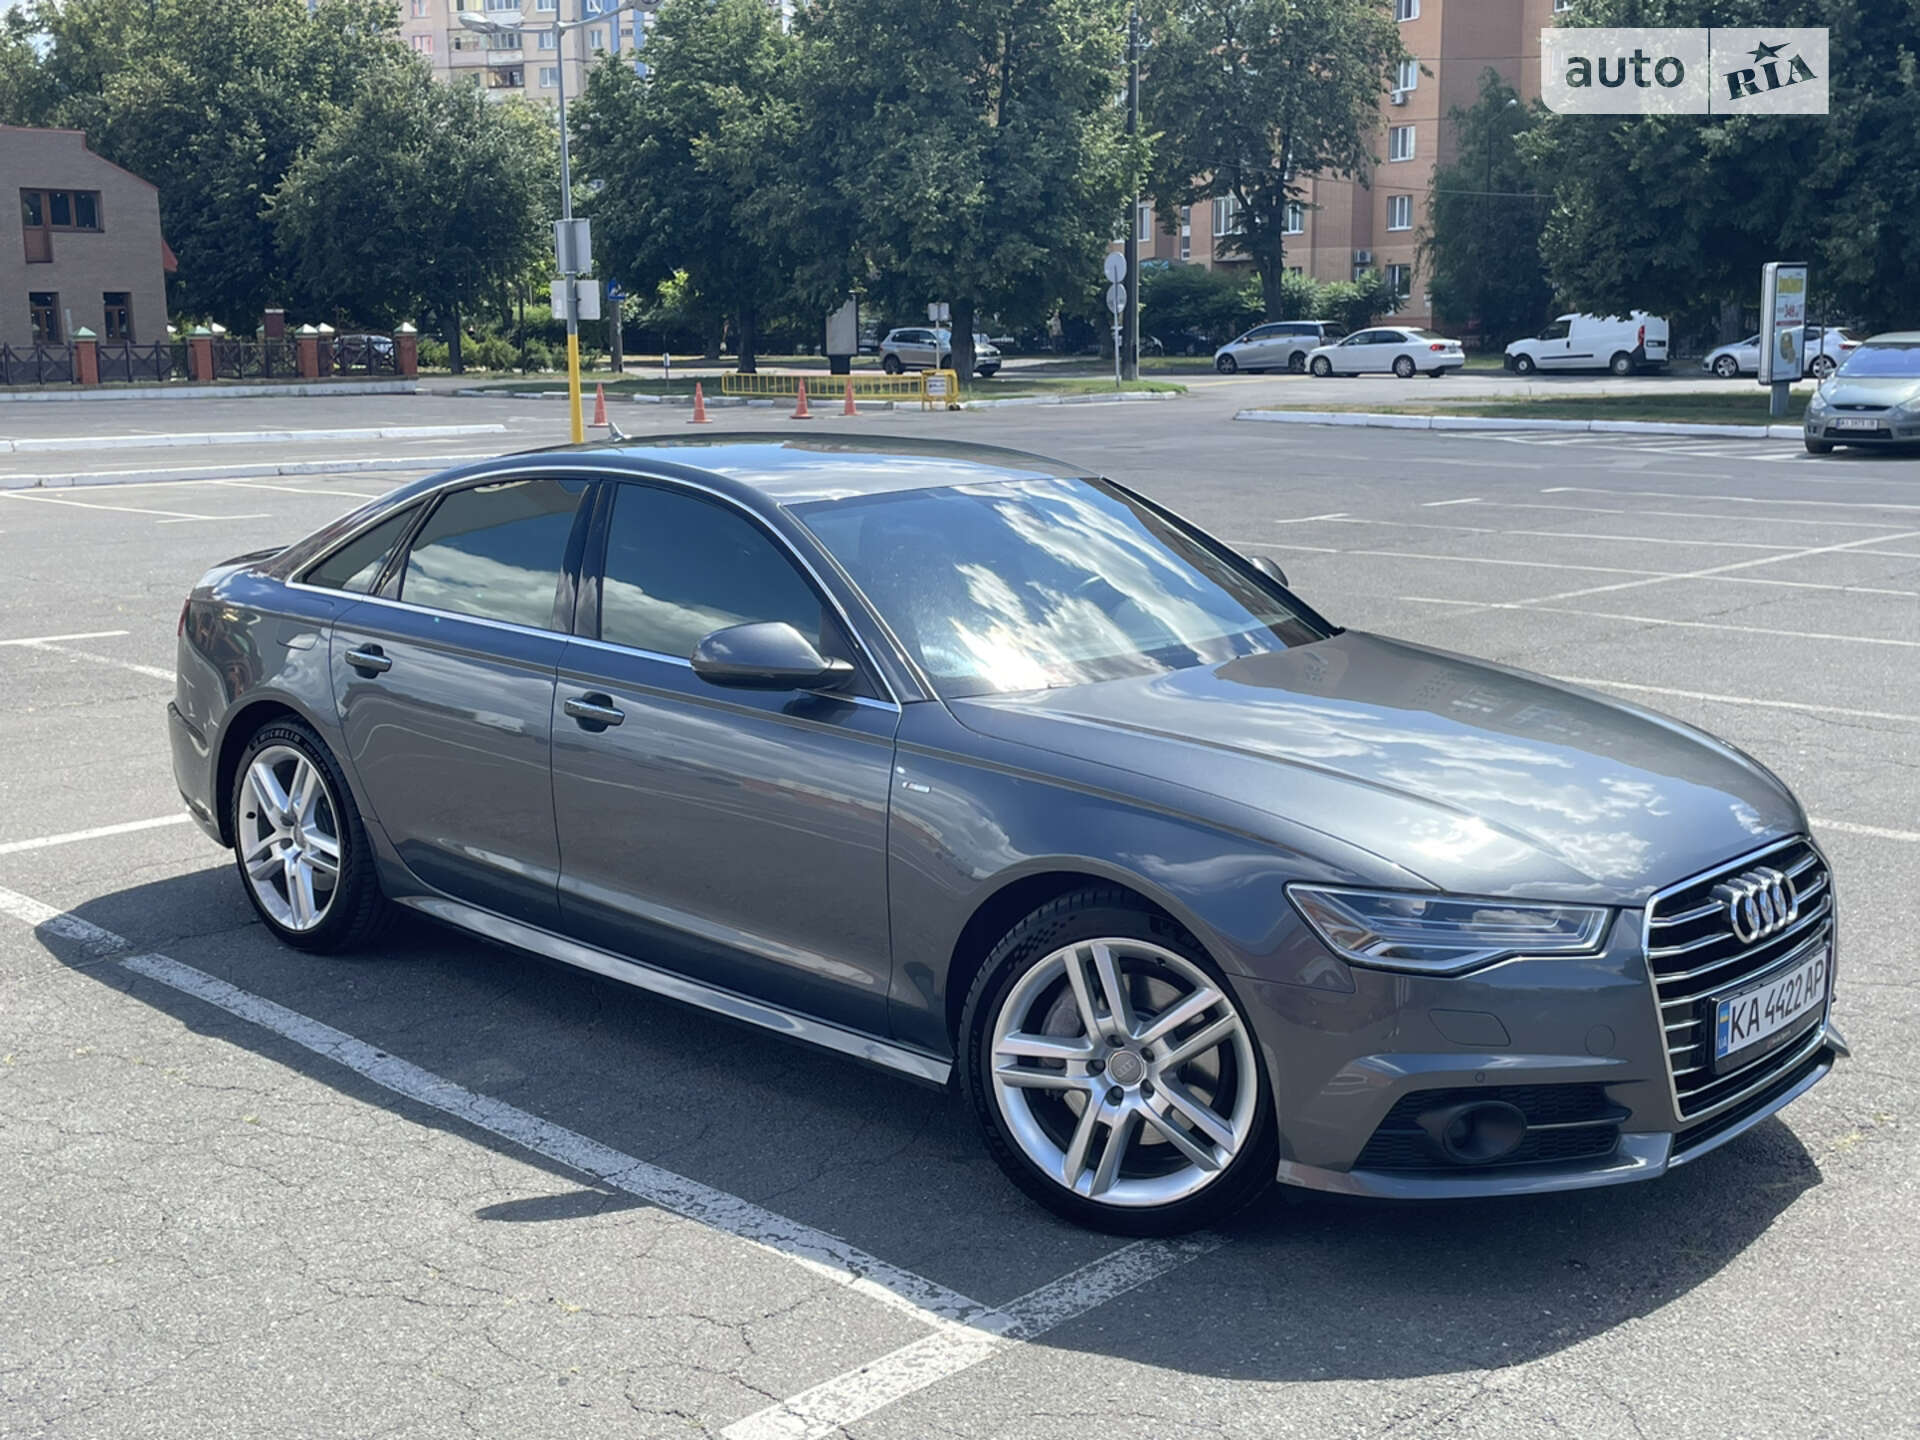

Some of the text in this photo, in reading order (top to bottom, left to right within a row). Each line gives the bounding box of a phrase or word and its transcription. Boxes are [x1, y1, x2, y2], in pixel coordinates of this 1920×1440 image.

[1731, 997, 1760, 1044] KA
[1765, 974, 1802, 1024] 4422
[1803, 959, 1824, 1003] AP
